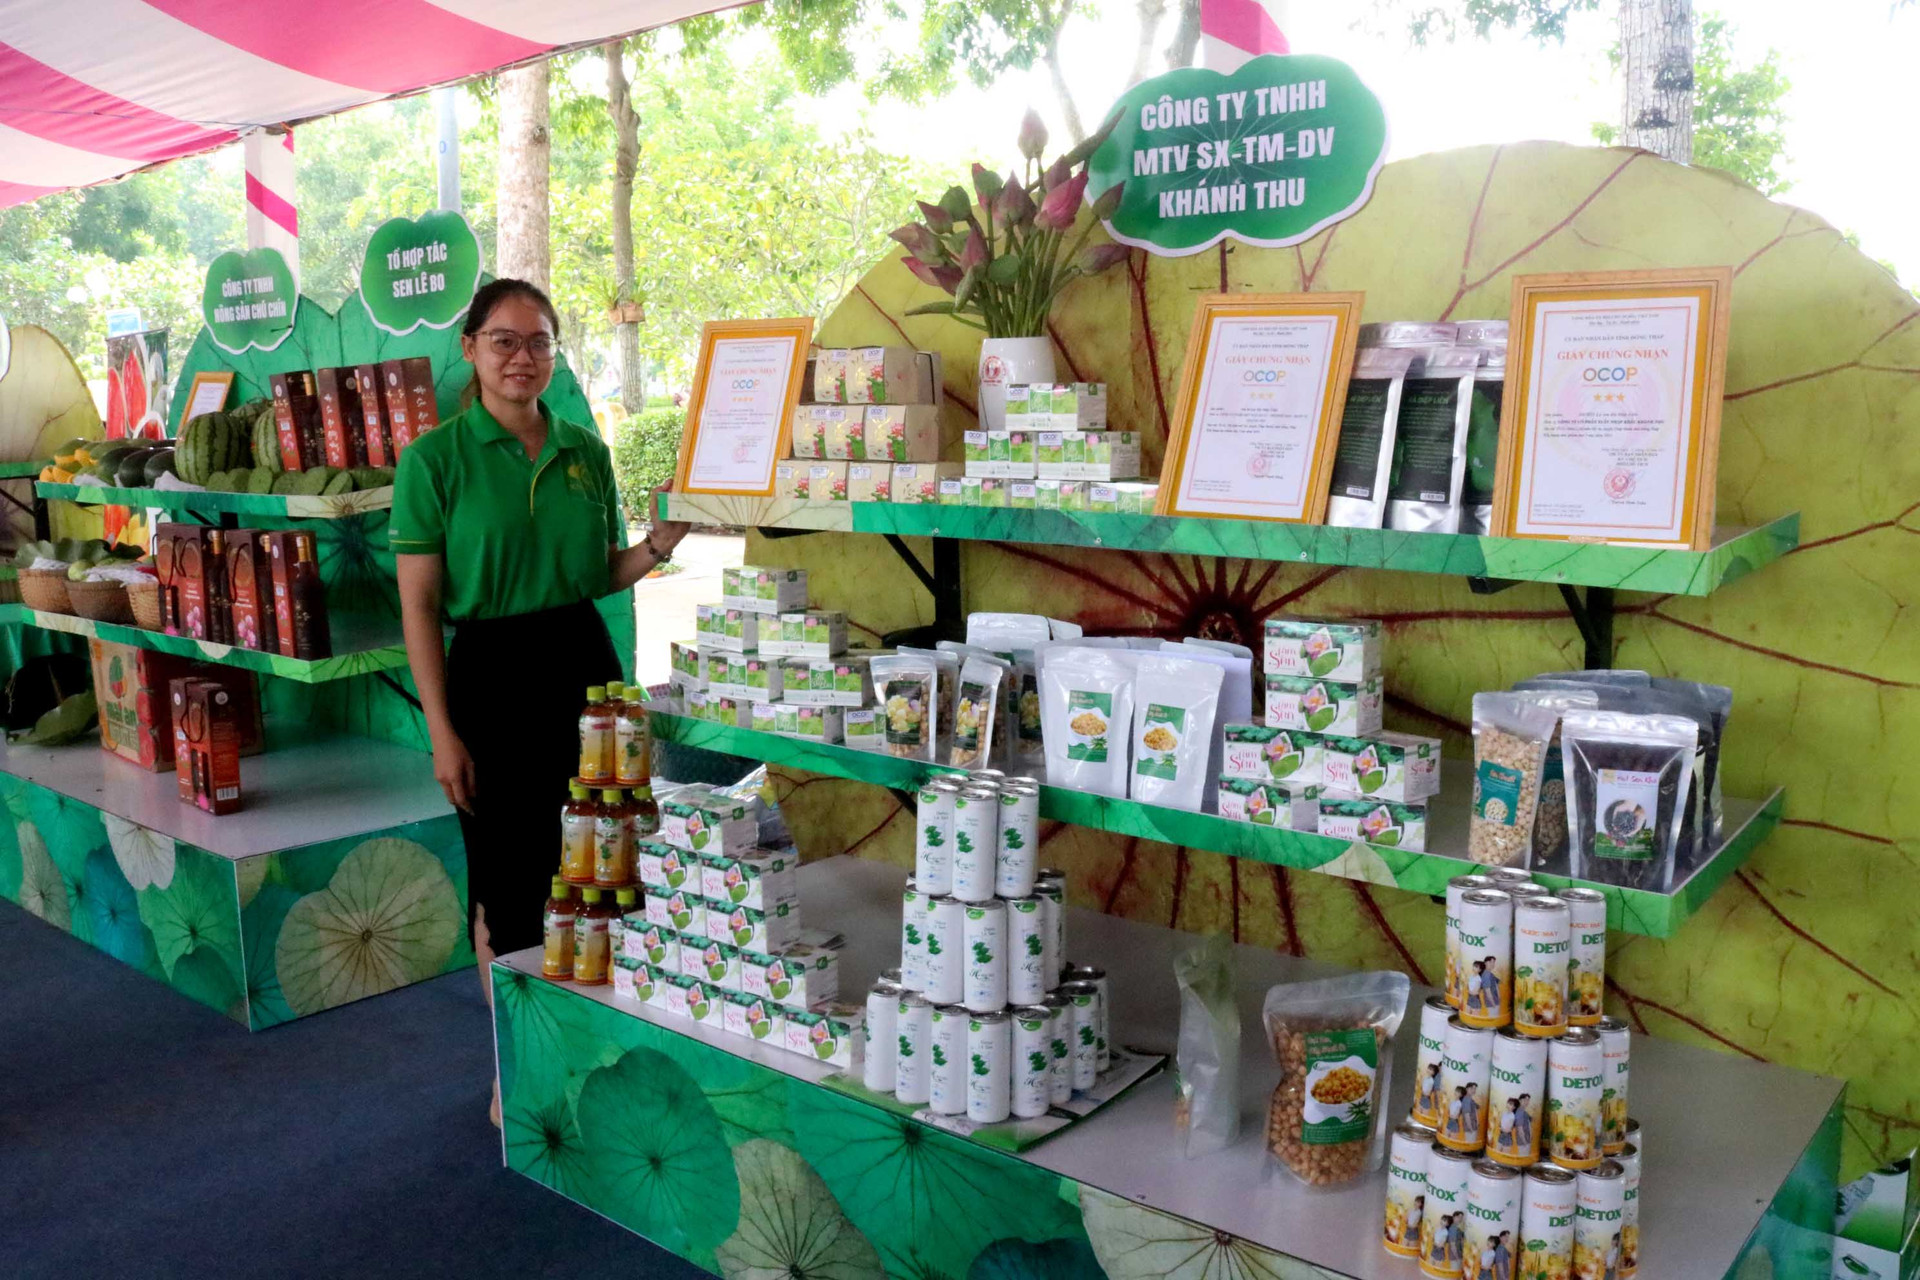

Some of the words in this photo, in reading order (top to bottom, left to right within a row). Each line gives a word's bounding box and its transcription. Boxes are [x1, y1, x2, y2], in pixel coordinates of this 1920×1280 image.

[1141, 95, 1209, 131] CÔNG
[1217, 91, 1247, 121] TY
[1255, 80, 1326, 117] TNHH
[1134, 146, 1189, 176] MTV
[1197, 127, 1335, 170] SX-TM-DV
[1159, 178, 1246, 218] KHÁNH
[1254, 178, 1305, 210] THU
[387, 250, 400, 271] TỔ
[402, 248, 424, 270] HỢP
[425, 241, 447, 262] TÁC
[222, 280, 243, 297] CÔNG
[243, 278, 252, 294] TY
[252, 277, 274, 294] TNHH
[393, 279, 413, 298] SEN
[415, 272, 428, 295] LÊ
[430, 273, 445, 292] BO
[732, 379, 760, 389] OCOP
[1244, 370, 1286, 382] OCOP
[1583, 366, 1638, 382] OCOP
[1534, 938, 1570, 953] DETO
[1582, 933, 1605, 945] DET
[1491, 1063, 1523, 1084] ETOX
[1426, 1182, 1457, 1202] ETOX
[1467, 1201, 1502, 1222] ETOX
